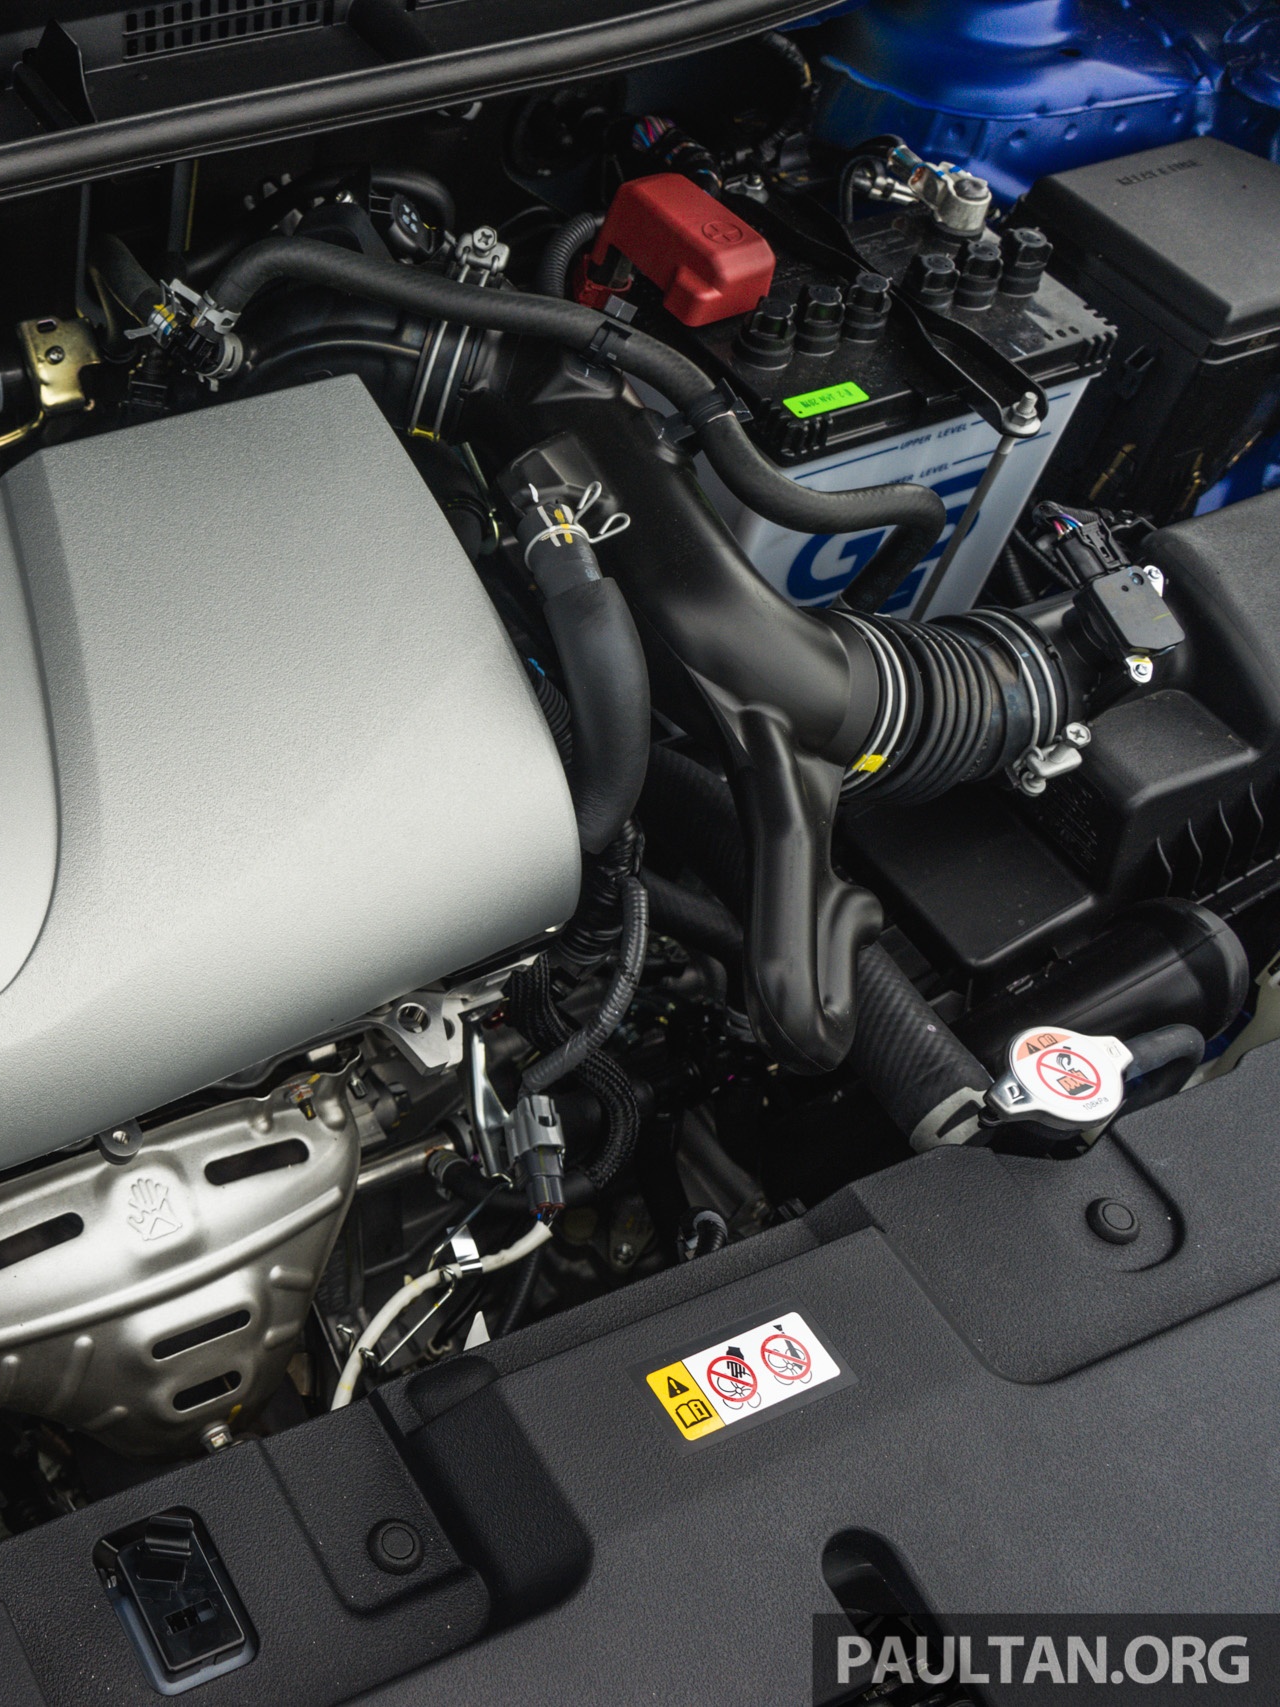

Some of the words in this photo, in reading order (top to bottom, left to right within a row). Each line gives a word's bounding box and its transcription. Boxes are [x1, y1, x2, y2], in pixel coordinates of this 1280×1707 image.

[900, 434, 932, 450] UPPER
[937, 423, 968, 439] LEVEL
[918, 461, 950, 479] LEVEL
